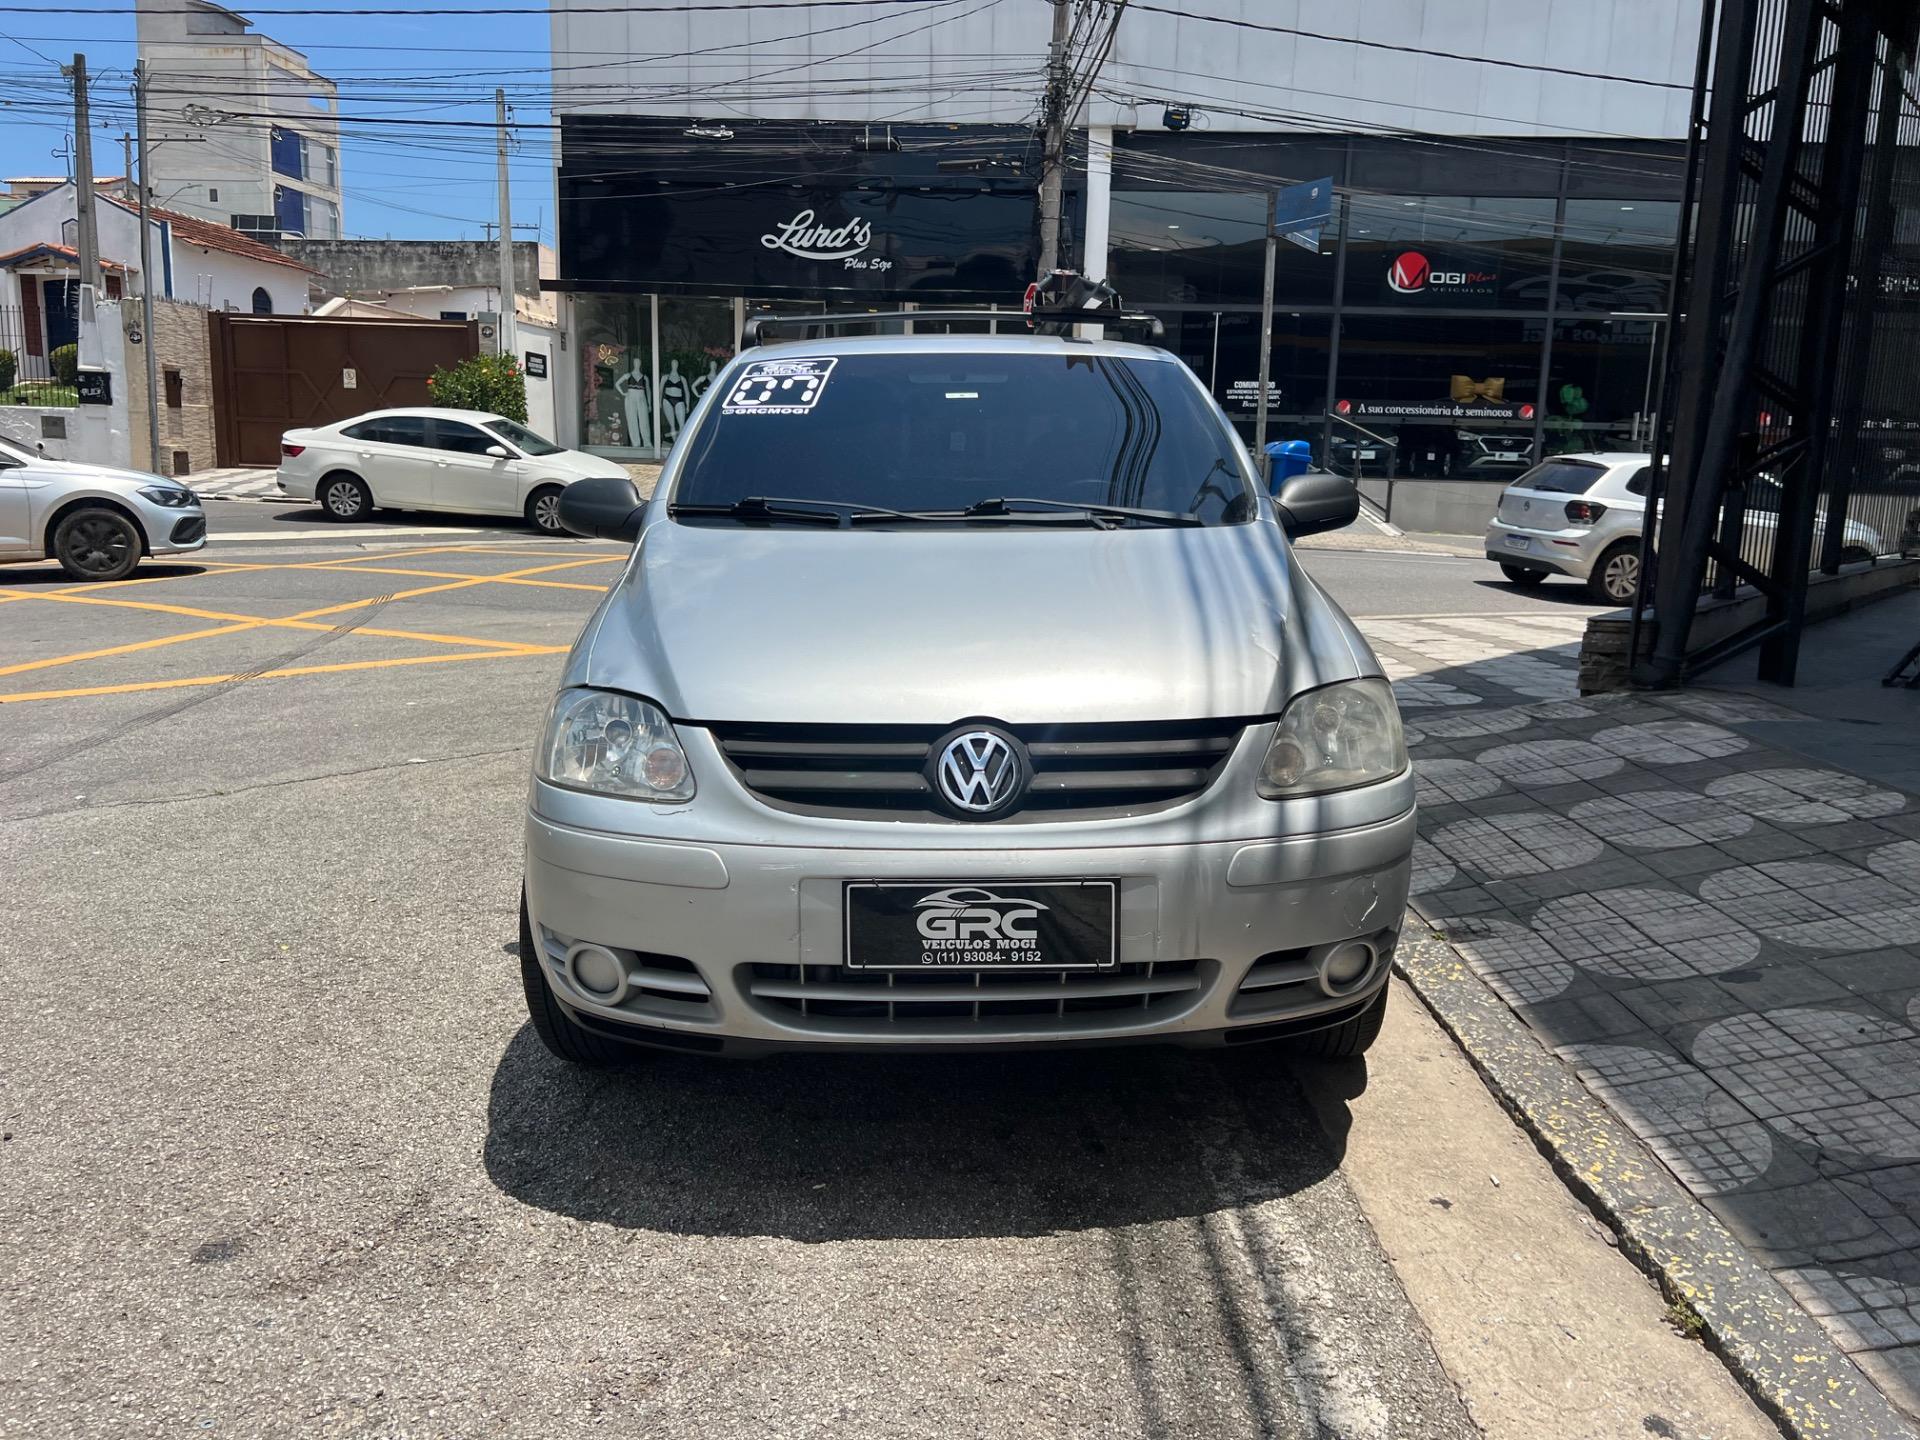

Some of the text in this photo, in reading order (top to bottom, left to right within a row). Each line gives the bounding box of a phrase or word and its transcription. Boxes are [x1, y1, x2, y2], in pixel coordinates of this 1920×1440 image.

[761, 209, 872, 260] Lurd's
[844, 258, 892, 272] Plus Size
[1358, 404, 1513, 418] A sua concessionária de seminovos
[916, 908, 1038, 939] GRC
[922, 939, 1037, 949] VEICULOS MOGI
[937, 951, 960, 963] (11)
[1011, 951, 1042, 962] 9152
